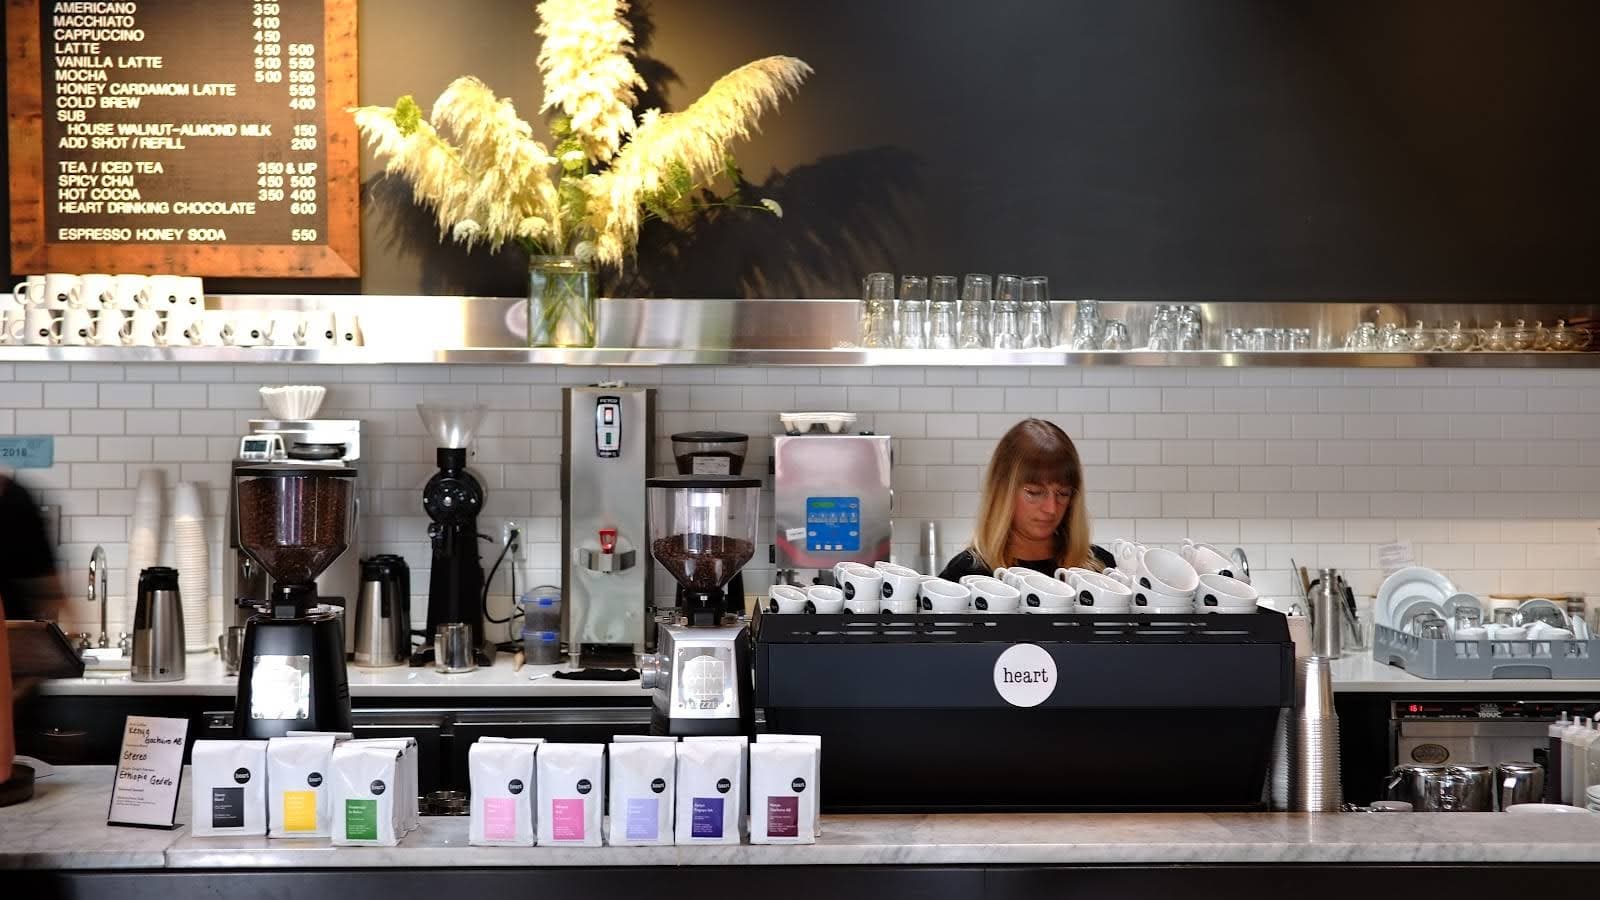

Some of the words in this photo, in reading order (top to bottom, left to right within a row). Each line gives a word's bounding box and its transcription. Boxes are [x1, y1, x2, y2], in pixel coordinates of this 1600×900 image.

[55, 2, 136, 14] AMERICANO
[254, 4, 279, 15] 350
[54, 16, 134, 27] MACCHIATO
[253, 17, 280, 29] 400
[55, 29, 144, 41] CAPPUCCINO
[254, 31, 280, 42] 450
[56, 43, 99, 54] LATTE
[254, 44, 280, 56] 450
[288, 44, 314, 56] 500
[56, 56, 113, 67] VANILLA
[118, 56, 162, 68] LATTE
[255, 57, 281, 69] 500
[289, 57, 315, 69] 550
[56, 70, 107, 81] MOCHA
[255, 71, 282, 83] 500
[289, 71, 315, 83] 550
[57, 83, 106, 94] HONEY
[110, 83, 189, 96] CARDAMOM
[192, 84, 237, 96] LATTE
[289, 84, 315, 96] 550
[57, 96, 96, 108] COLD
[100, 97, 140, 108] BREW
[289, 98, 316, 110] 400
[58, 110, 85, 121] SUB
[68, 123, 114, 135] HOUSE
[117, 124, 237, 136] WALNUT-ALMOND
[241, 124, 272, 136] MILK
[294, 125, 317, 136] 150
[59, 137, 88, 148] ADD
[92, 137, 129, 149] SHOT
[140, 137, 185, 149] REFILL
[291, 138, 316, 150] 200
[60, 162, 87, 173] TEA
[101, 162, 133, 173] ICED
[135, 162, 163, 173] TEA
[258, 162, 284, 174] 350
[298, 163, 317, 174] UP
[59, 175, 98, 186] SPICY
[101, 175, 133, 187] CHAI
[258, 176, 283, 187] 450
[291, 176, 316, 187] 500
[59, 188, 87, 200] HOT
[91, 188, 140, 200] COCOA
[259, 189, 284, 201] 350
[291, 189, 316, 201] 400
[59, 202, 104, 213] HEART
[108, 202, 169, 214] DRINKING
[173, 202, 256, 214] CHOCOLATE
[291, 203, 316, 214] 600
[59, 228, 131, 240] ESPRESSO
[136, 229, 184, 240] HONEY
[188, 229, 226, 241] SODA
[292, 229, 316, 241] 550
[1003, 667, 1048, 683] heart
